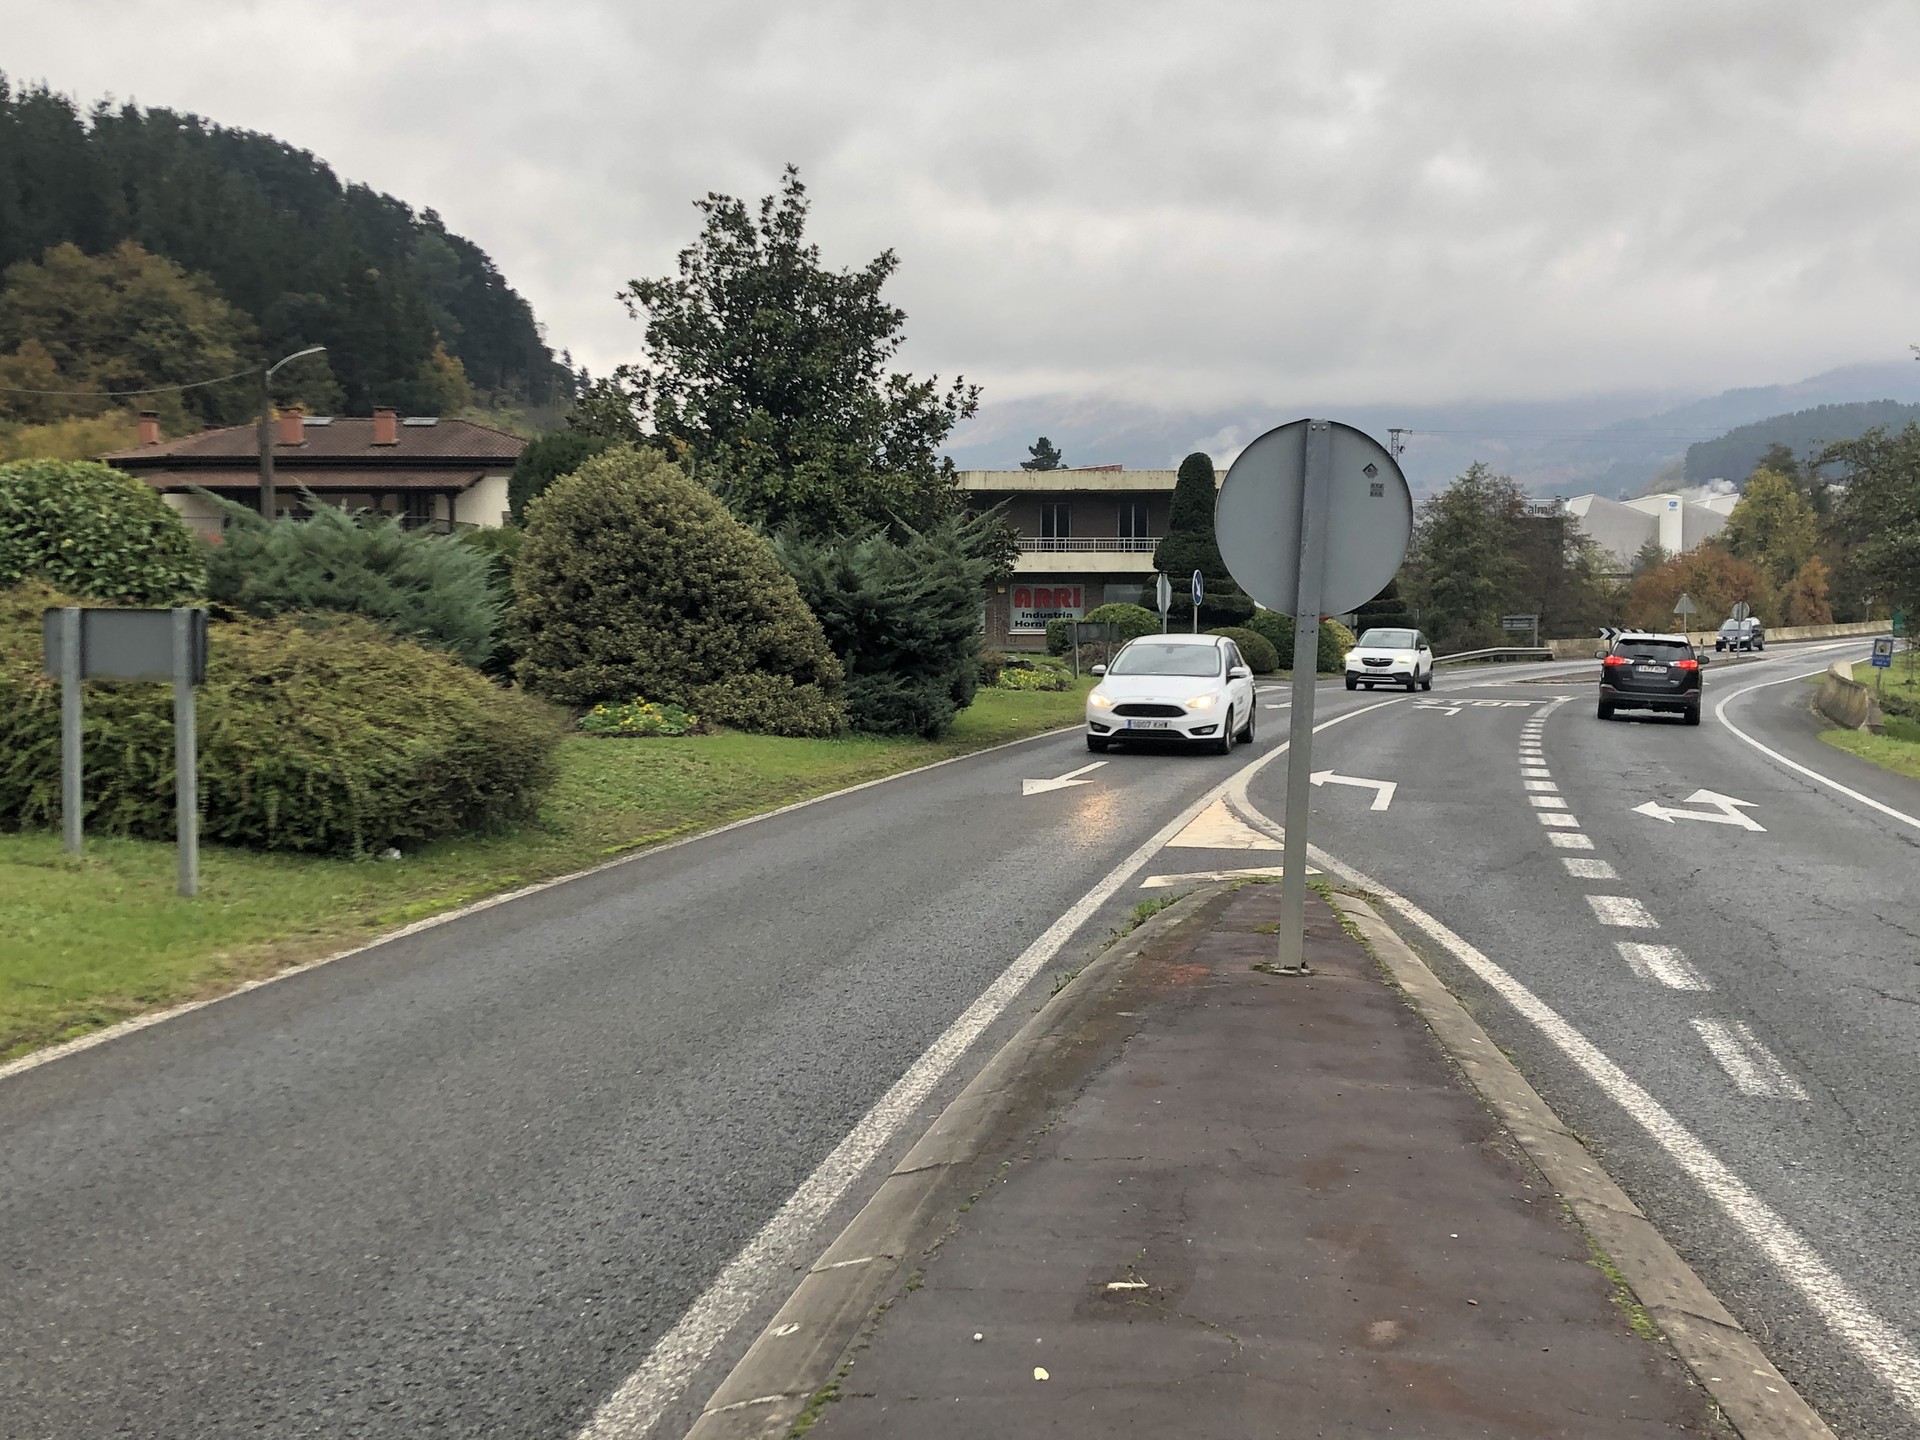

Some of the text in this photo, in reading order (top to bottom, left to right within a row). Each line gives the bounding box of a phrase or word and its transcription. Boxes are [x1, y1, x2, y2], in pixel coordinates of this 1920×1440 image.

[1014, 587, 1081, 608] ARRI
[1021, 611, 1073, 619] Industria
[1014, 620, 1046, 628] Horni
